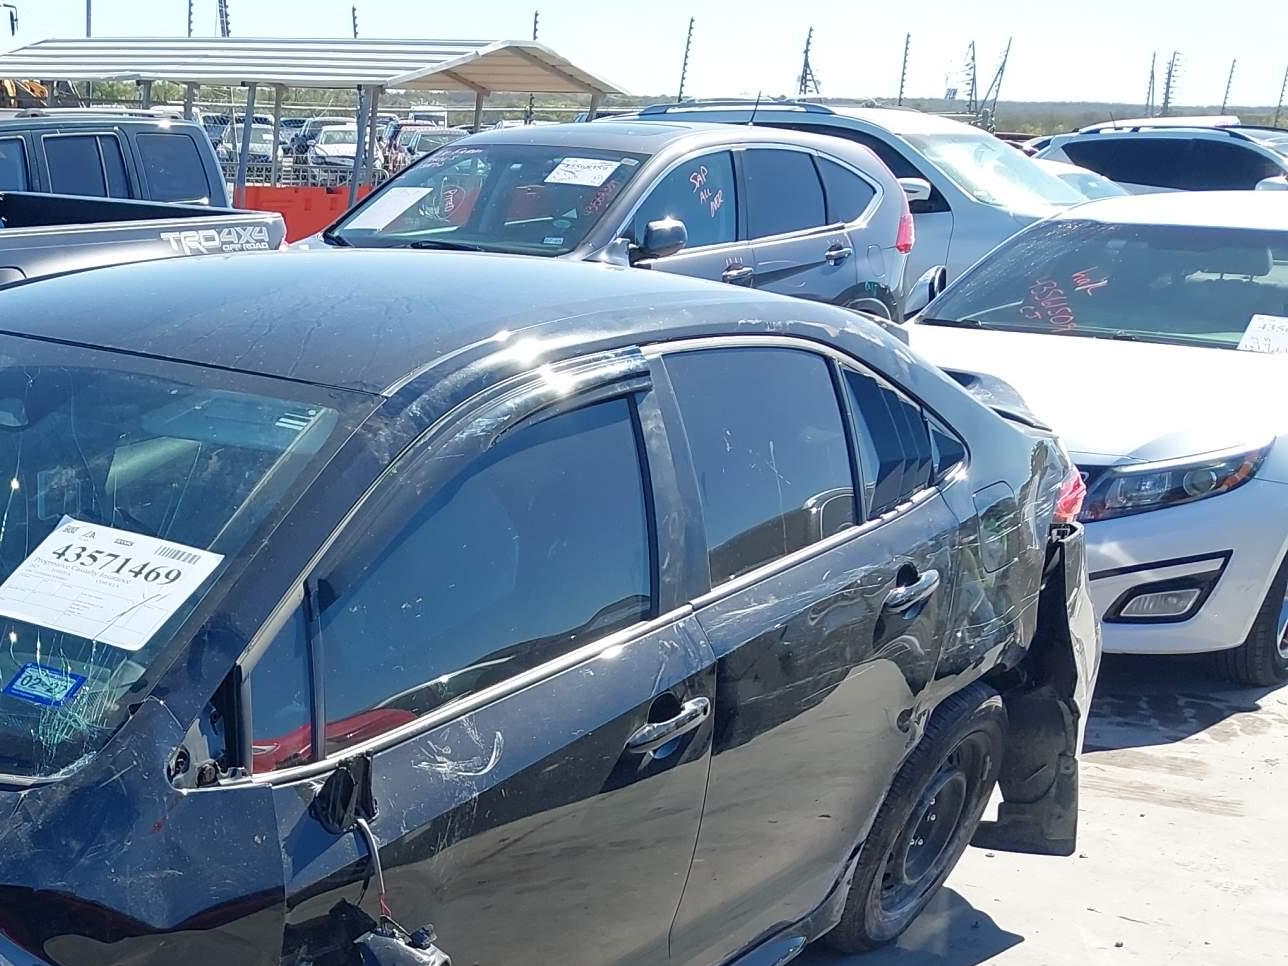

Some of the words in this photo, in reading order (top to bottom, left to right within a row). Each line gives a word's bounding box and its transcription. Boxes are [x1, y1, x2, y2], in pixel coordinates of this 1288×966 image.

[160, 229, 222, 255] TRD
[222, 244, 242, 252] OFF
[242, 242, 270, 250] ROAD
[52, 543, 182, 586] 43571469
